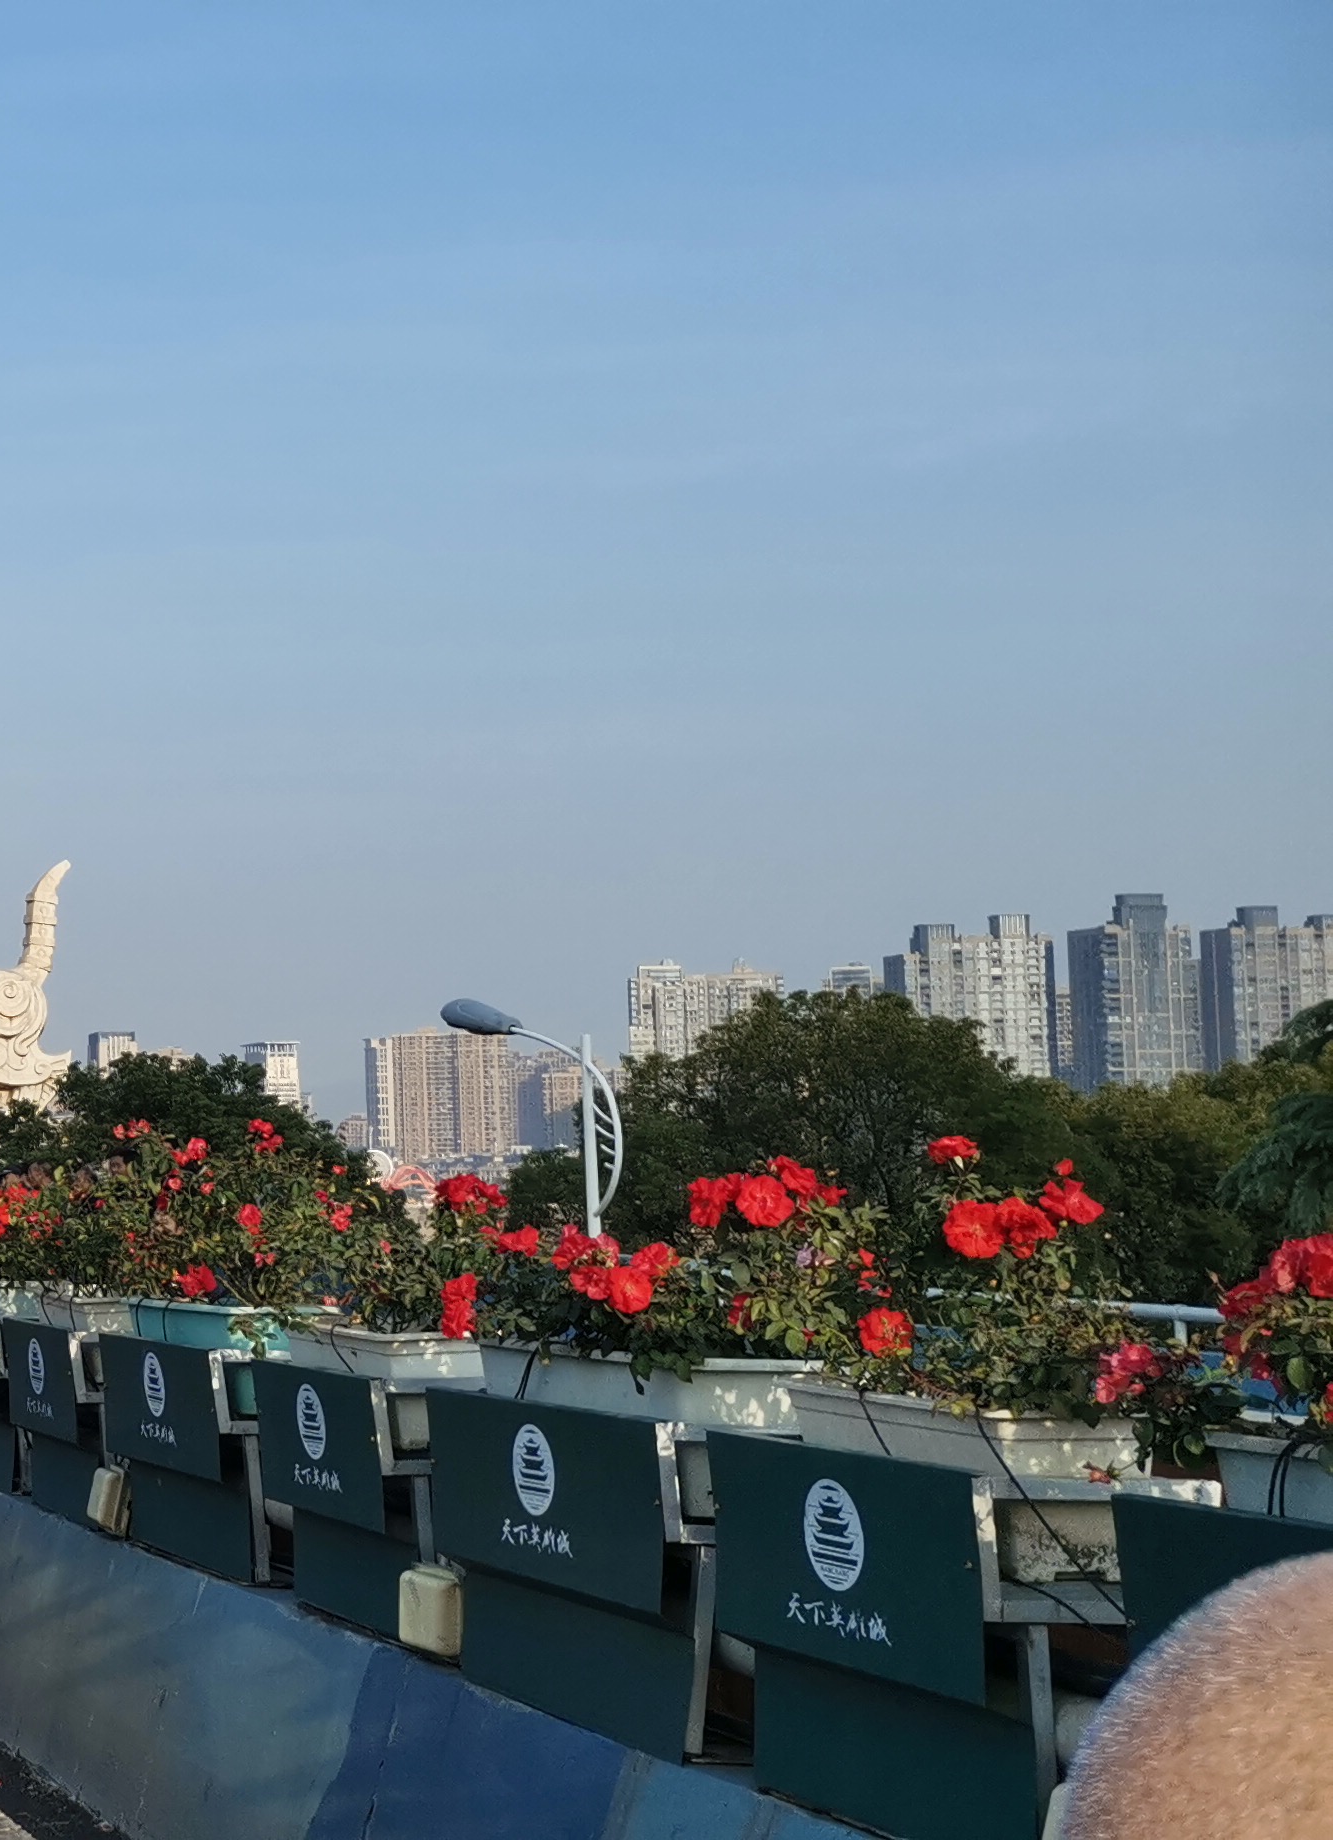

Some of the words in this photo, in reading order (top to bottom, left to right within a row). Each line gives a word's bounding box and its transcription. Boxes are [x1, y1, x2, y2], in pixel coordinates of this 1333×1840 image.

[786, 1592, 893, 1647] 天下英雄城
